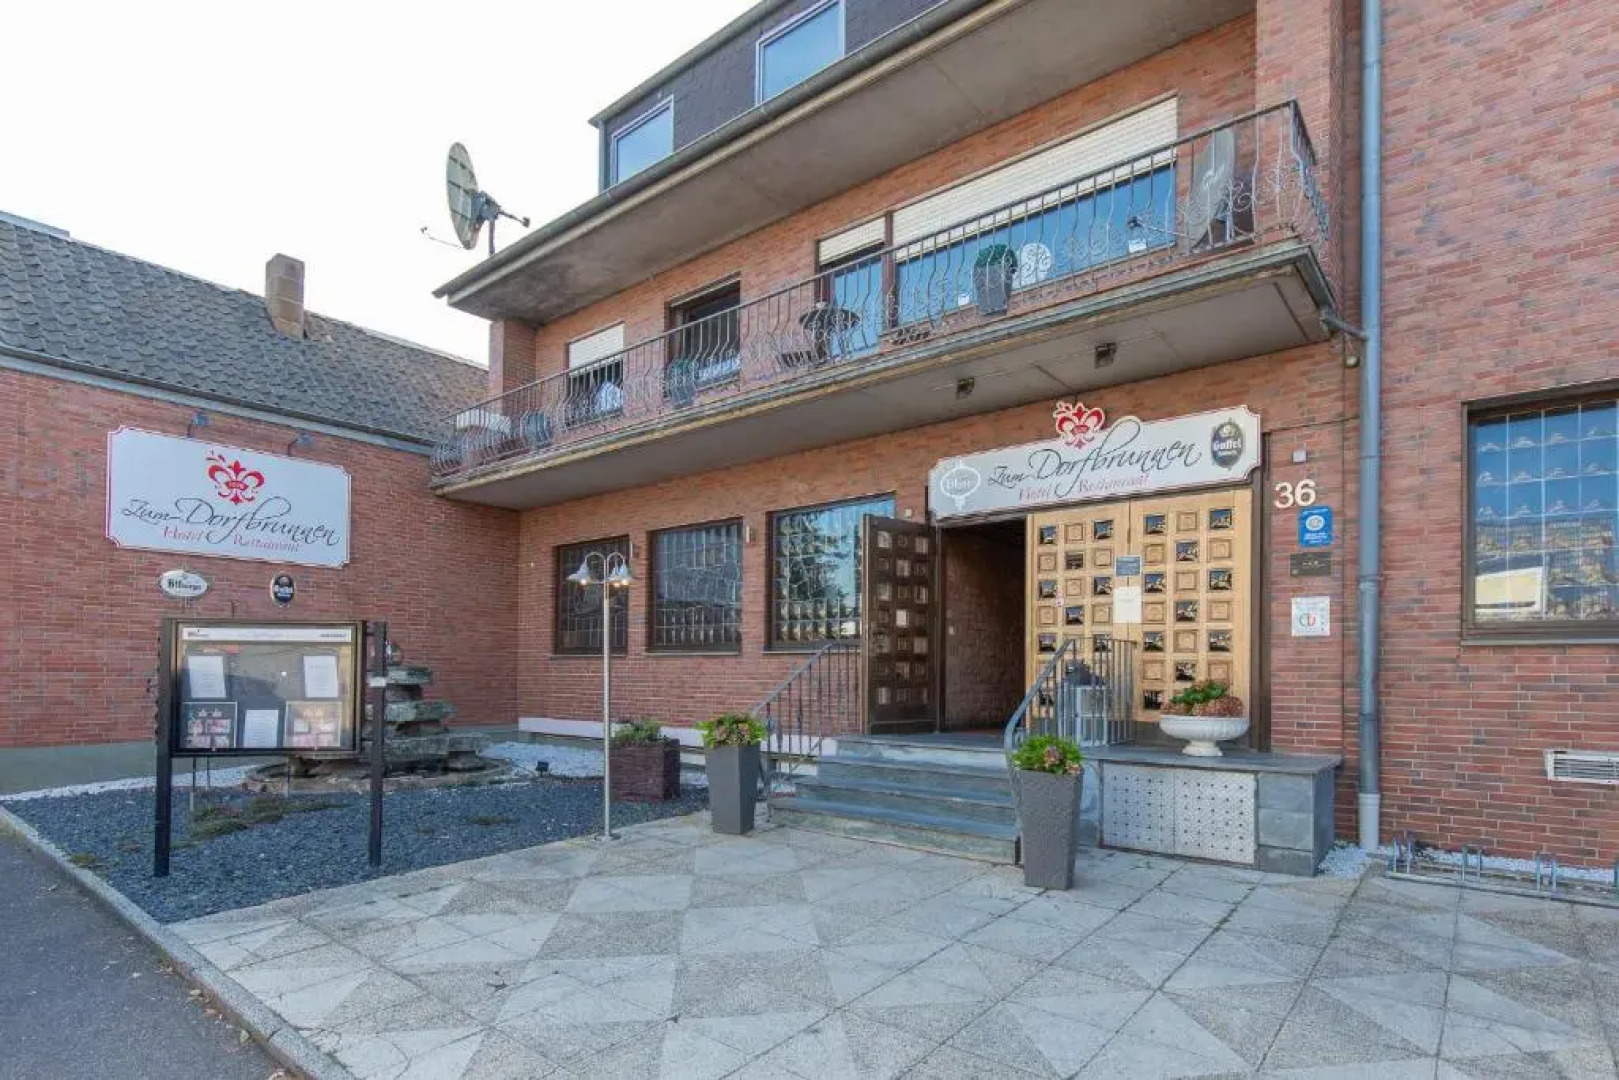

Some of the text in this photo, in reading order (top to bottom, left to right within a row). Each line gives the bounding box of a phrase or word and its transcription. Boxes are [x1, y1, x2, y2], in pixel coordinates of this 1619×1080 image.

[988, 418, 1203, 498] Zum Dorfbrunnen
[1019, 475, 1152, 501] Hotel Restaurant
[1274, 479, 1317, 508] 36
[121, 496, 342, 546] Zum Dorfbrunnen
[163, 526, 300, 552] Hotel Restaurant
